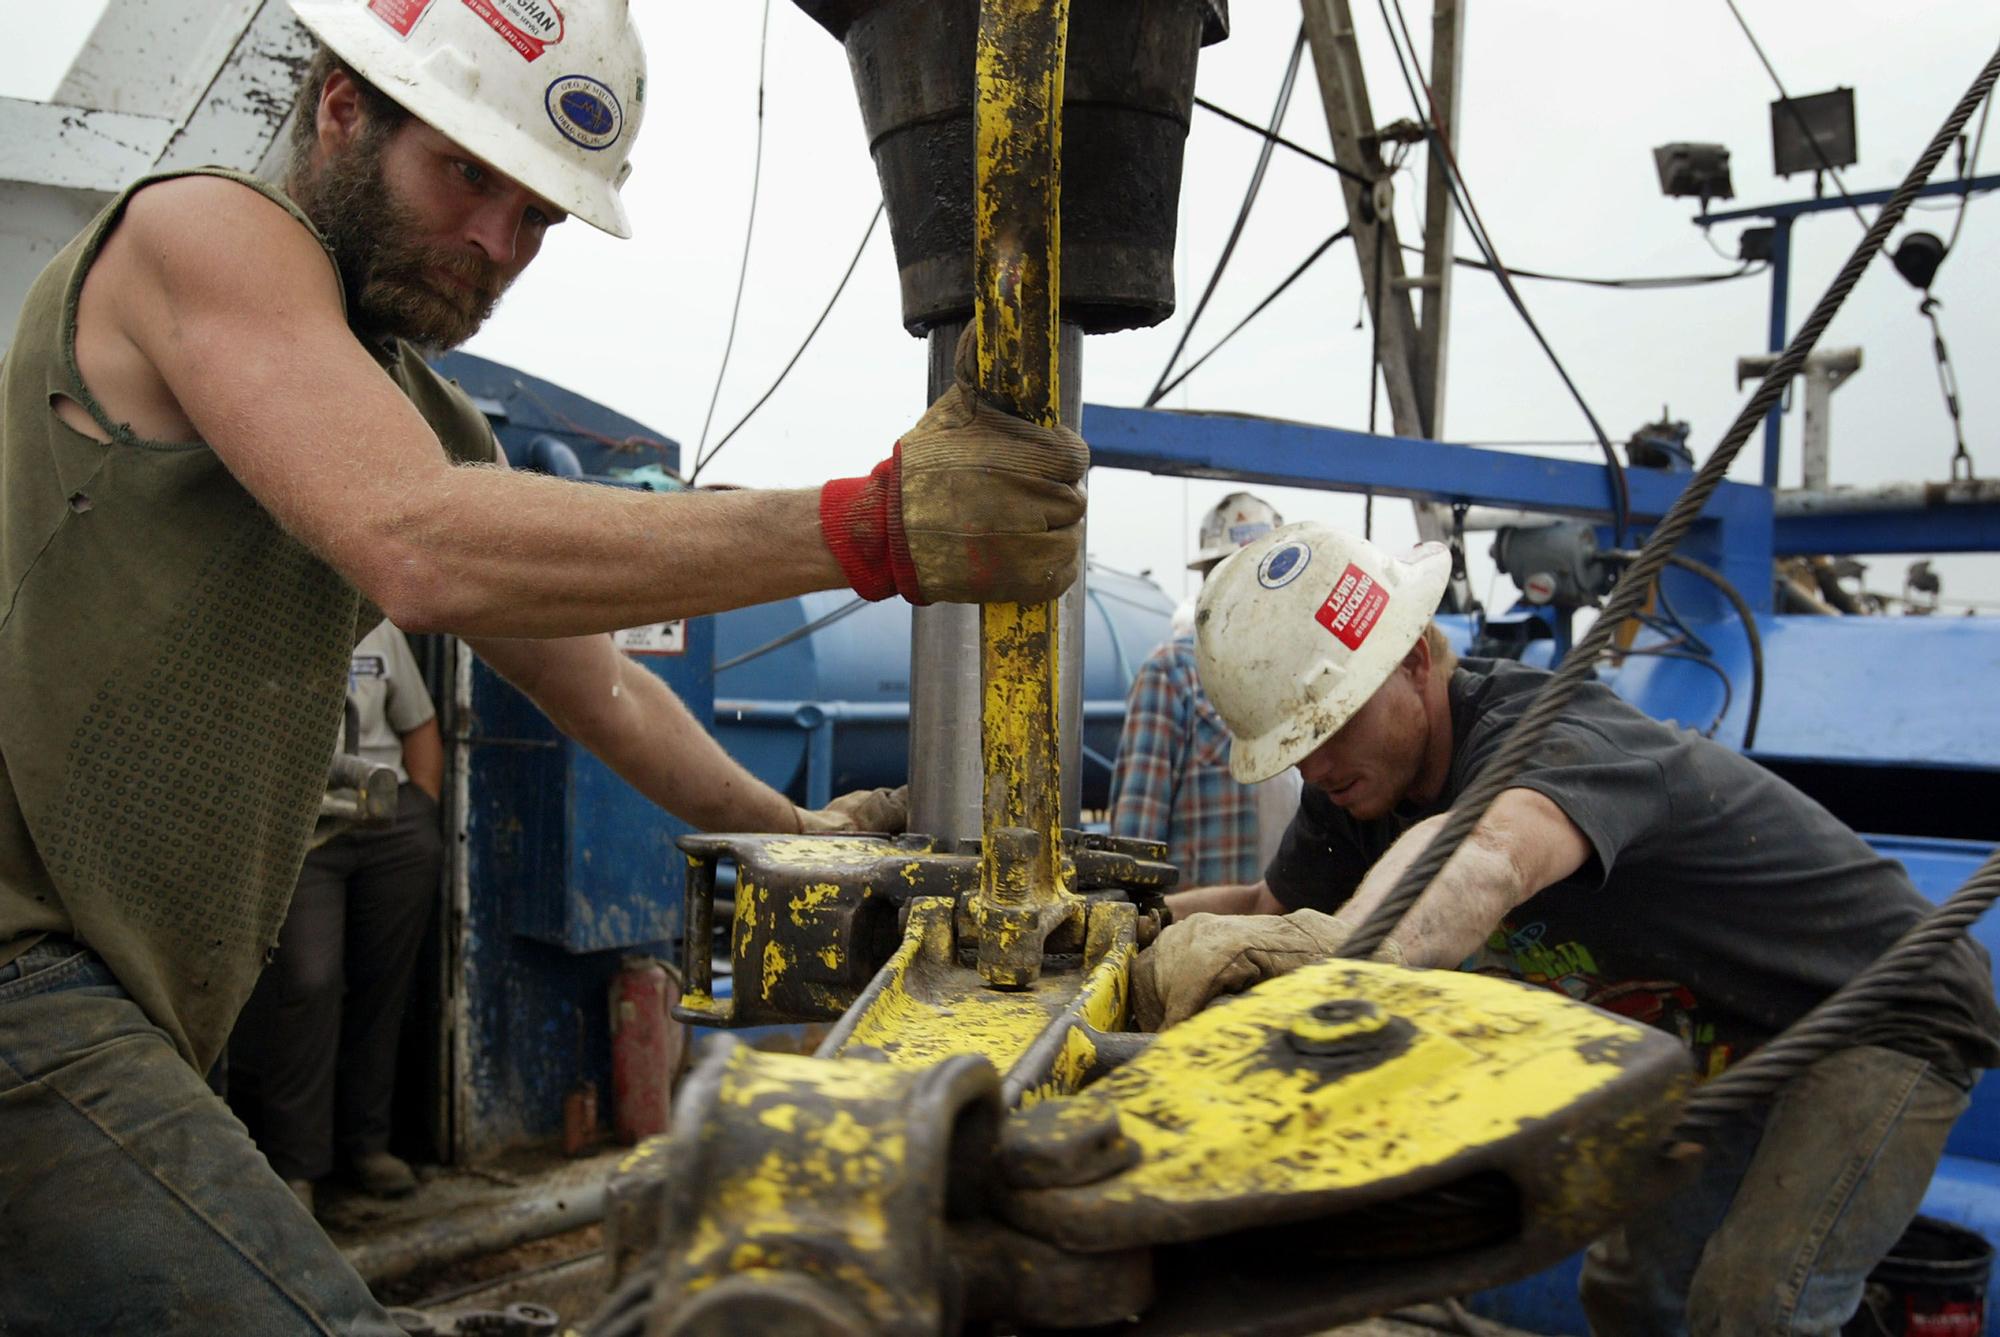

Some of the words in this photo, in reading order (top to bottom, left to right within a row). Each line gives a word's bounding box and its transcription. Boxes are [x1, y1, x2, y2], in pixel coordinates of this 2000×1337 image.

[520, 16, 539, 35] SERVICE
[1327, 574, 1357, 611] LEWIS
[1331, 574, 1372, 632] TRUCKING
